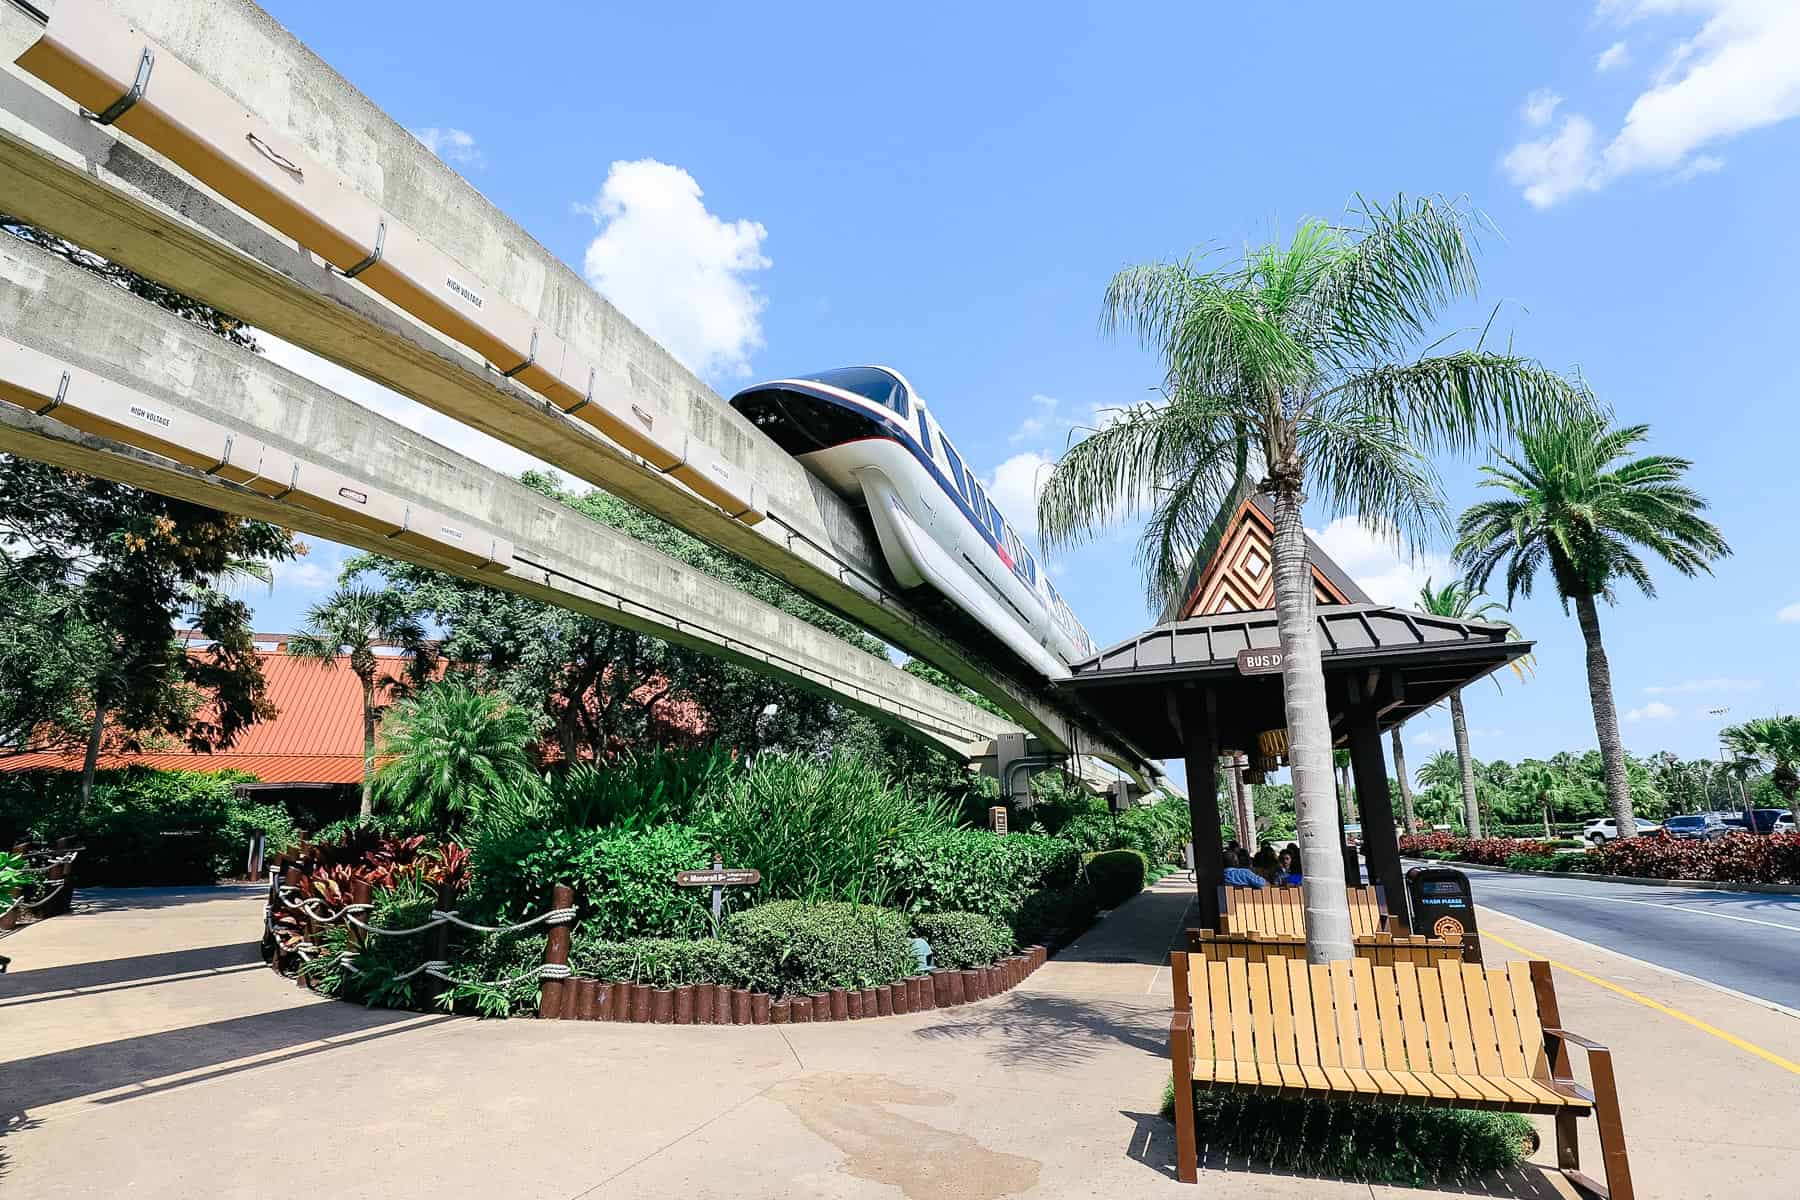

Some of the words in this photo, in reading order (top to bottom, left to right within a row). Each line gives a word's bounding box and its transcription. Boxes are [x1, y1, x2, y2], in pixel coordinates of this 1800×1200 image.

[446, 277, 460, 293] HIGH
[461, 287, 482, 308] VOLTAGE
[130, 406, 146, 417] HIGH
[146, 411, 170, 426] VOLTAGE
[1247, 655, 1270, 668] BUS
[1272, 654, 1283, 666] D
